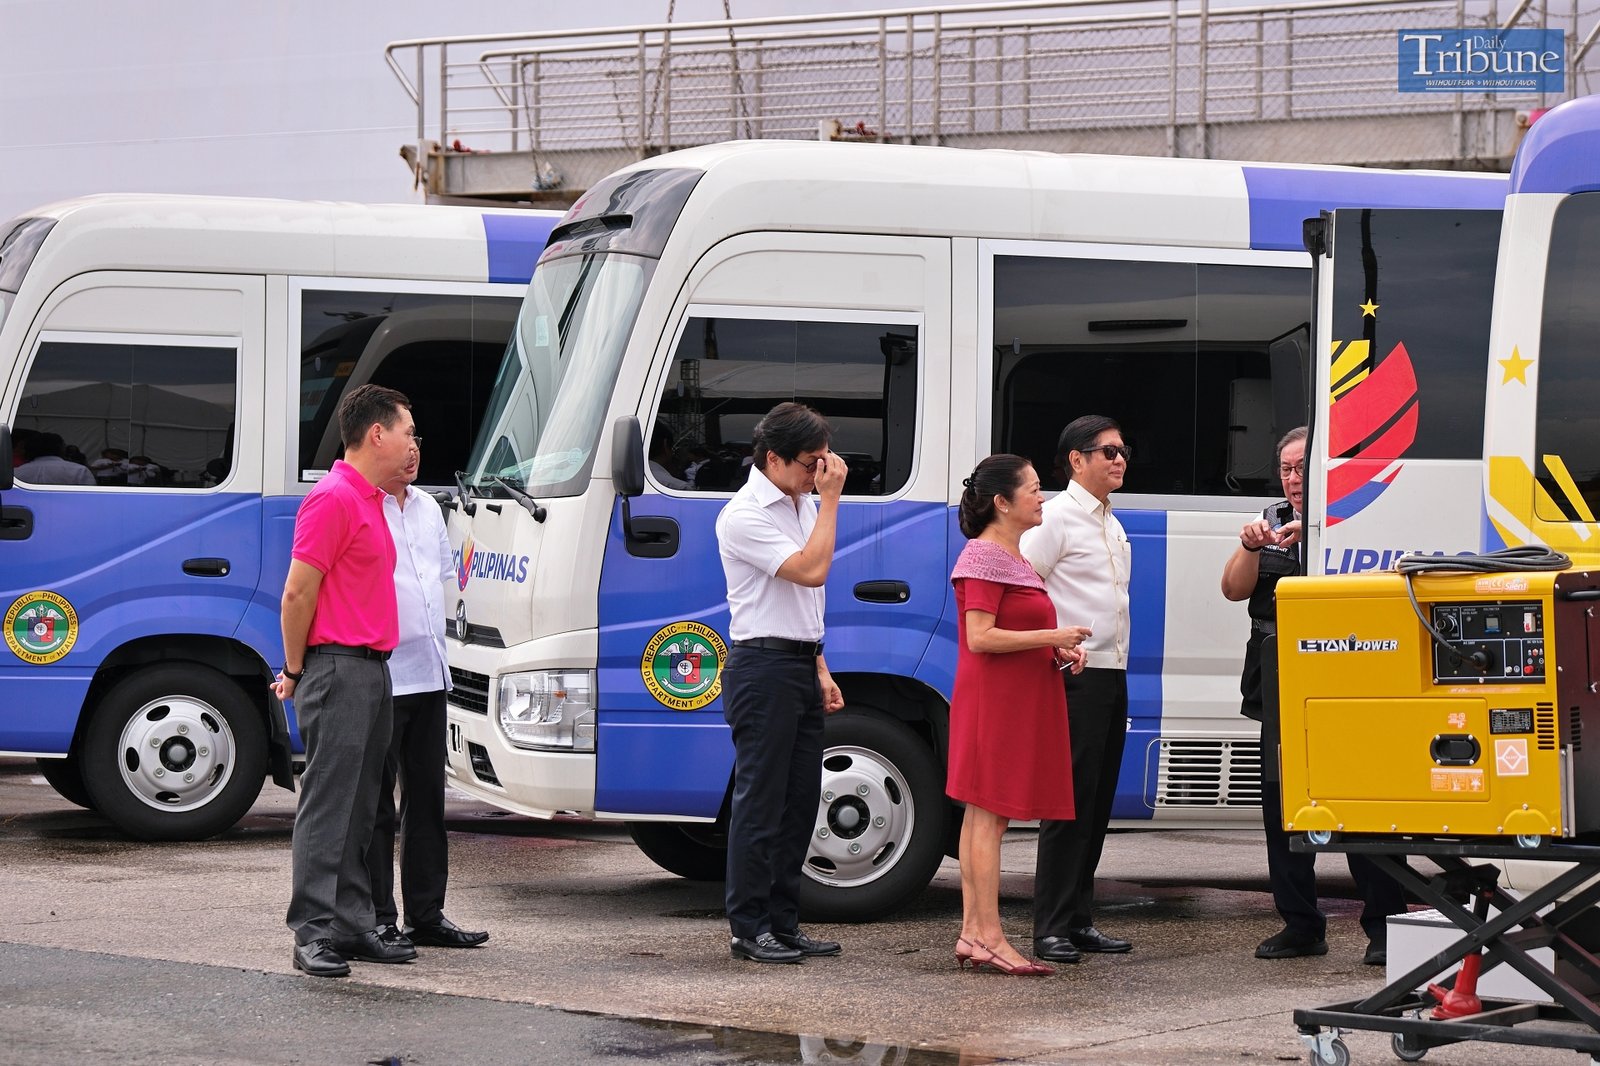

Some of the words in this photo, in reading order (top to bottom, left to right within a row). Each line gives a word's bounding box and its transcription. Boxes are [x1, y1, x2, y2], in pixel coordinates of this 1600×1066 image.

[470, 551, 530, 584] PILIPINAS
[6, 594, 34, 625] REPUBLIC
[42, 592, 77, 626] PHILIPPINES
[5, 631, 48, 662] DEPARTMENT
[56, 630, 77, 657] HEALTH
[644, 625, 678, 663] REPUBLIC
[686, 623, 727, 663] PHILIPPINES
[1298, 639, 1350, 653] LETAN
[1354, 639, 1399, 652] POWER
[643, 670, 694, 708] DEPARTMENT
